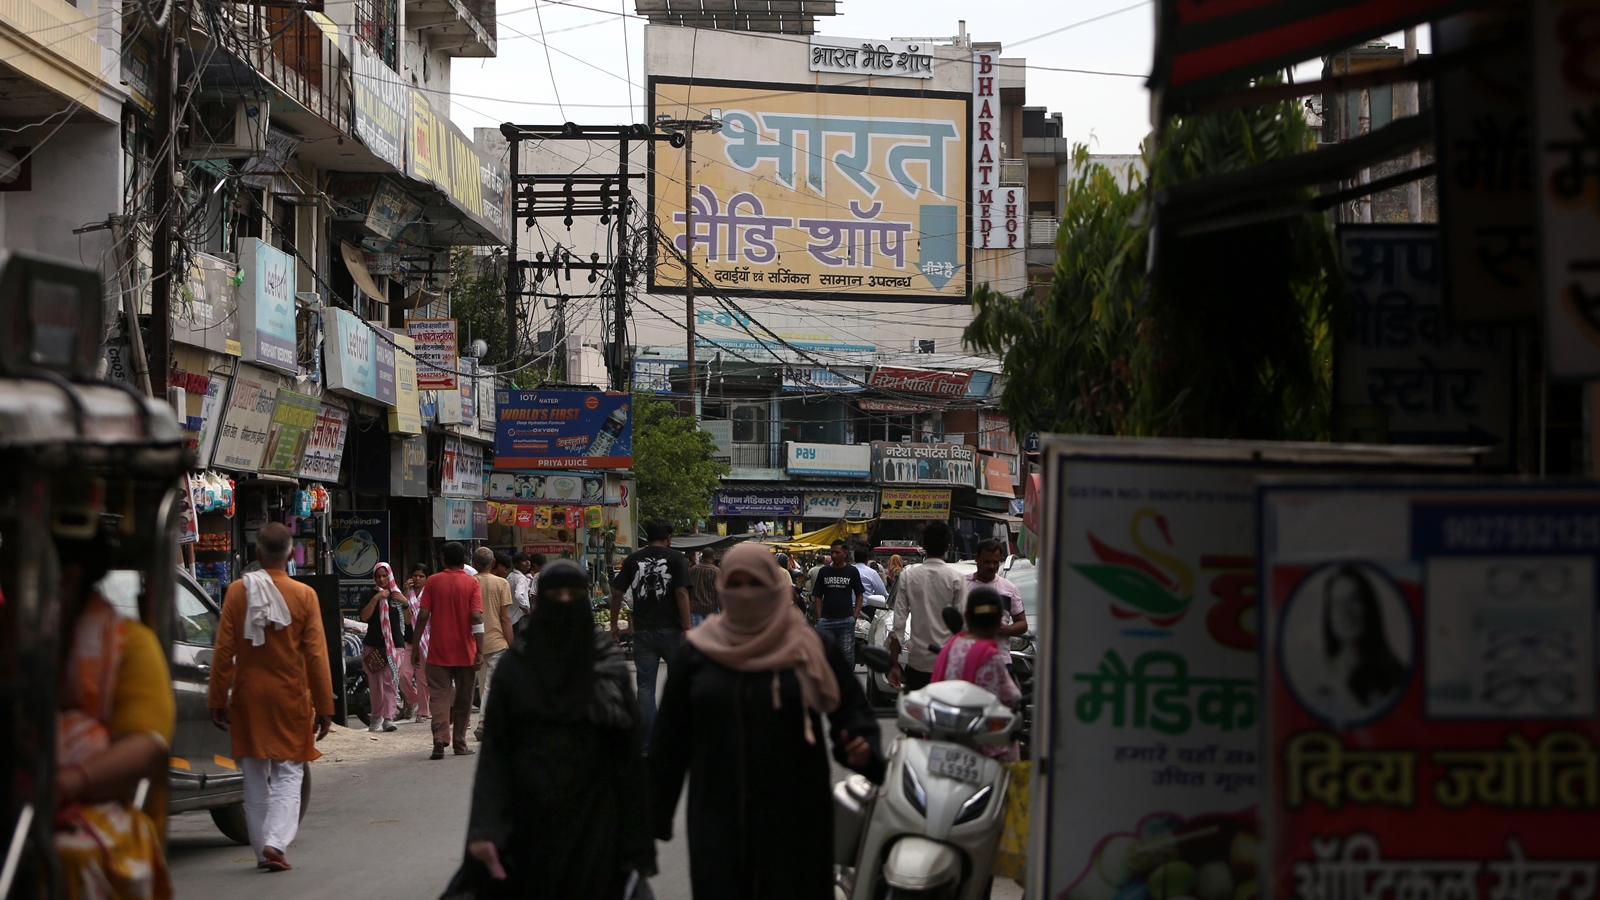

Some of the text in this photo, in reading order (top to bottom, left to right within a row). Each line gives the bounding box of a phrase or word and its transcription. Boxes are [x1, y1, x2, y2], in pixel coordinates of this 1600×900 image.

[812, 46, 858, 68] भारत
[898, 45, 933, 74] शॉप
[978, 54, 994, 184] BHARAT
[720, 110, 960, 200] भारत
[672, 186, 913, 270] मैडि शॉप
[979, 190, 993, 248] MEDI
[1006, 190, 1018, 248] SHOP
[820, 272, 862, 287] सामान
[501, 408, 580, 420] WORLD'S FIRST
[886, 444, 911, 457] नरेश
[950, 445, 972, 460] वियर
[824, 577, 851, 585] BURBERRY
[1285, 731, 1600, 810] दिव्य ज्योति
